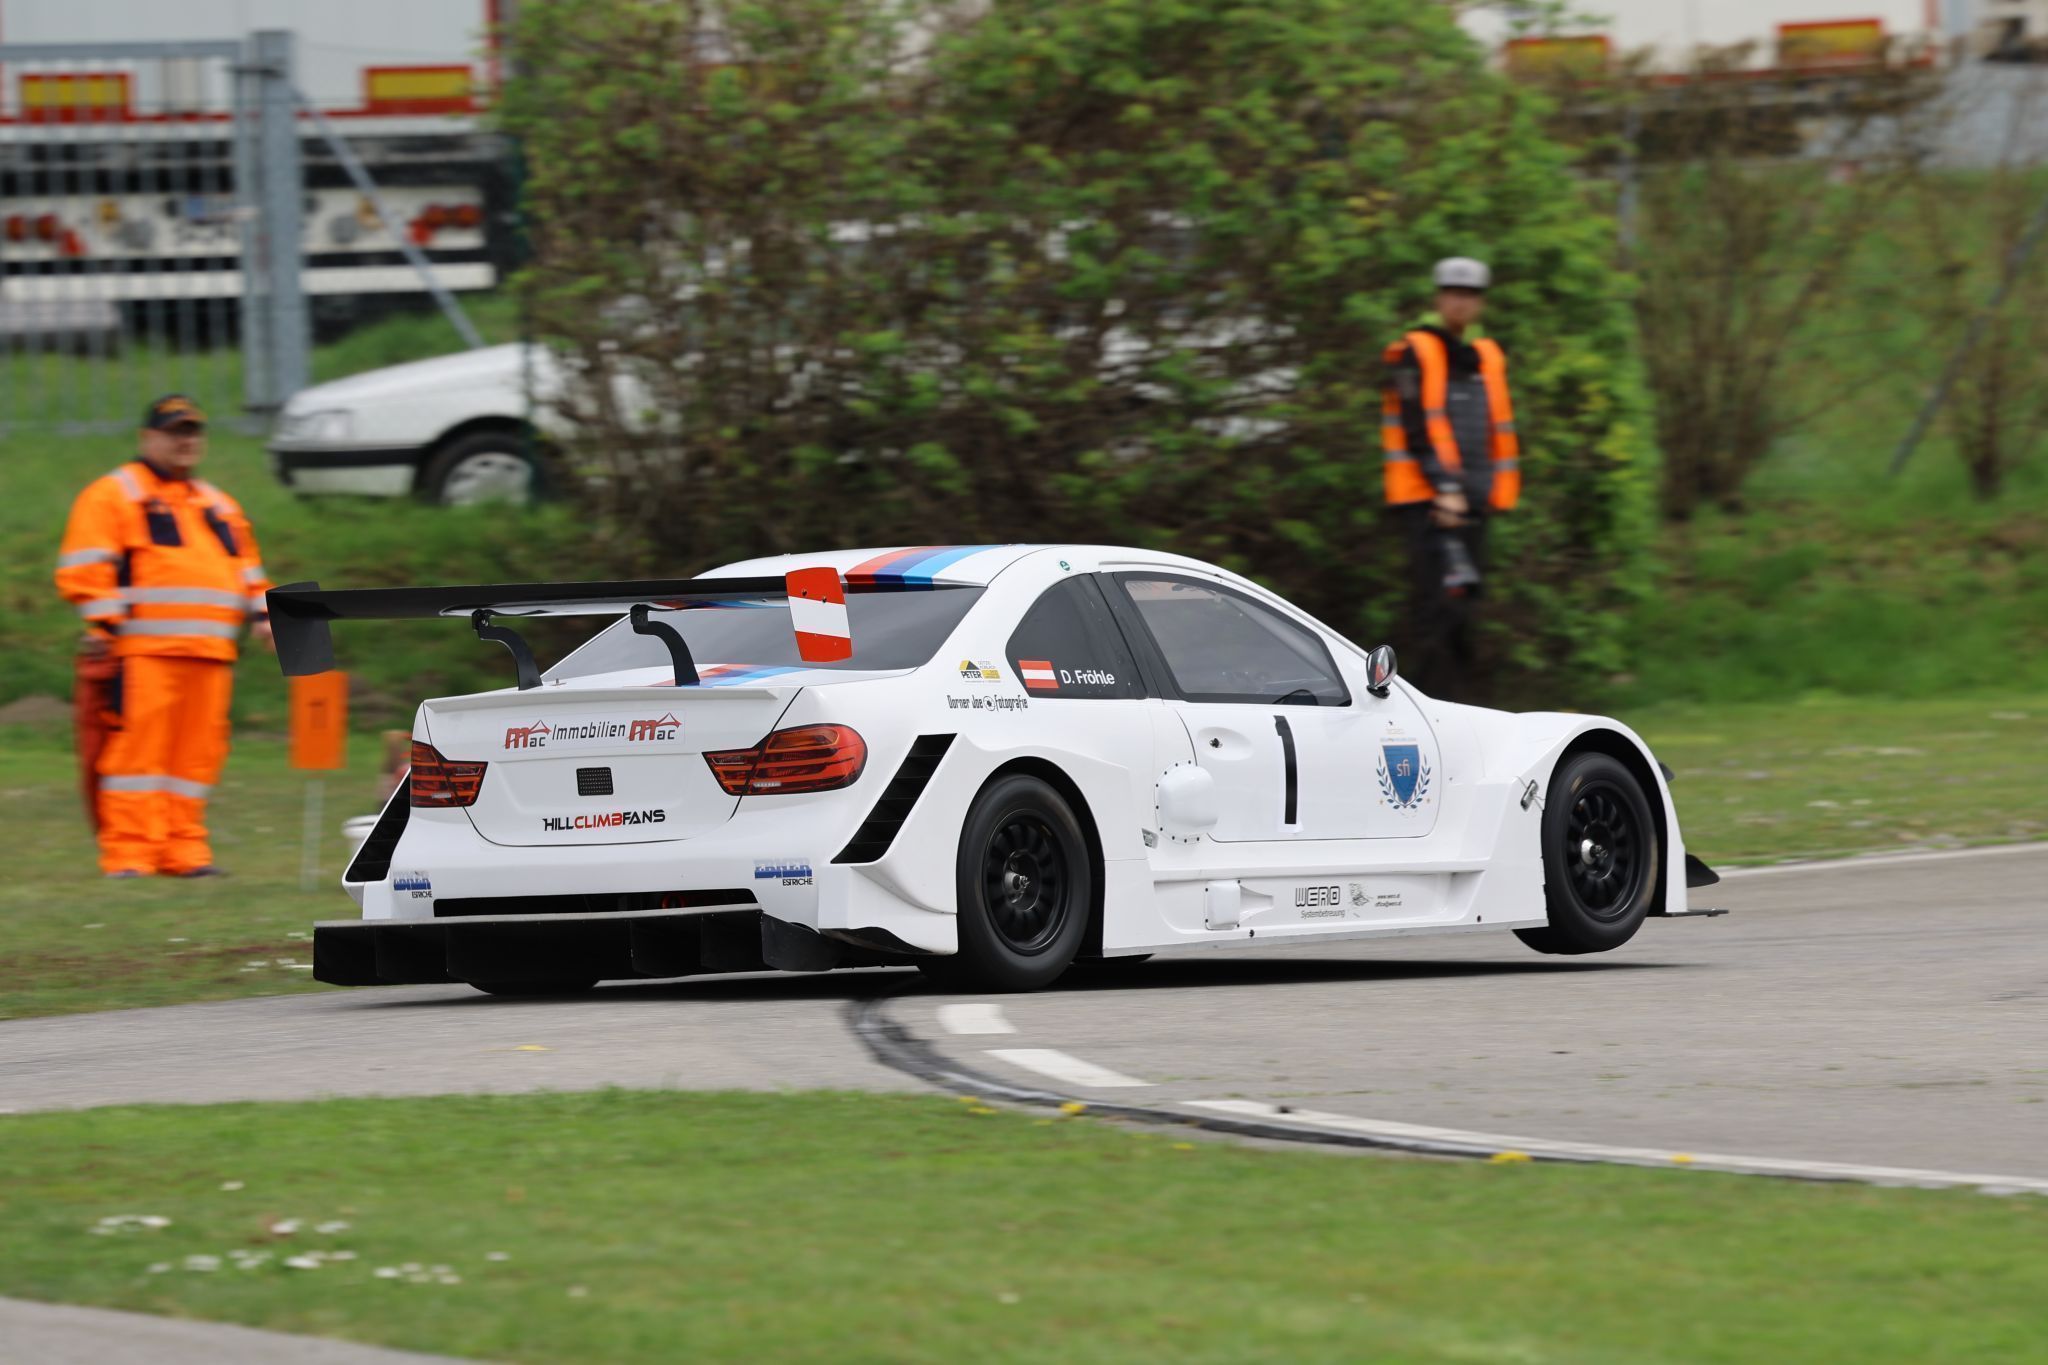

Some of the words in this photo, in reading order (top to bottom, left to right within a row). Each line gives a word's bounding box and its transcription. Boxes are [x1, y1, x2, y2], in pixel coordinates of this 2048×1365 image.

[960, 670, 983, 679] PETER
[1060, 669, 1074, 684] D.
[1077, 670, 1116, 685] Fröhle
[552, 722, 626, 740] Immobilien
[1273, 715, 1298, 824] 1
[1396, 758, 1411, 777] sfi
[542, 809, 666, 831] HILLCLIMBFANS
[782, 878, 814, 886] ESTRICHE
[1295, 886, 1340, 907] WERO
[1300, 909, 1345, 919] Systembetreuung
